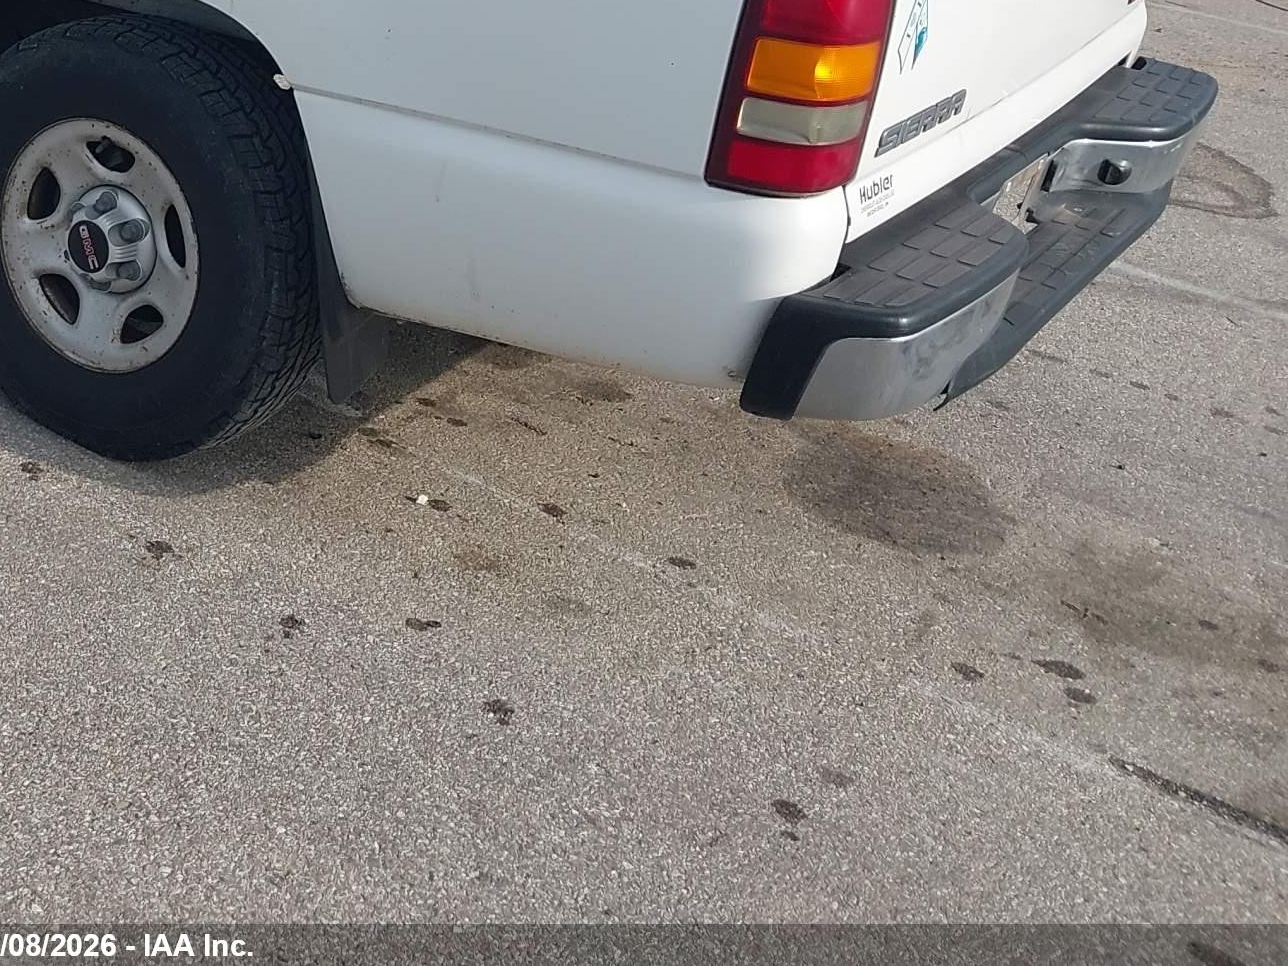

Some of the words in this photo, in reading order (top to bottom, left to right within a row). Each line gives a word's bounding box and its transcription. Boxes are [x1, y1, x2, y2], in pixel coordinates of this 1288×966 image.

[874, 89, 966, 158] SIERRA
[859, 174, 893, 205] Hubler
[79, 225, 99, 270] GMC
